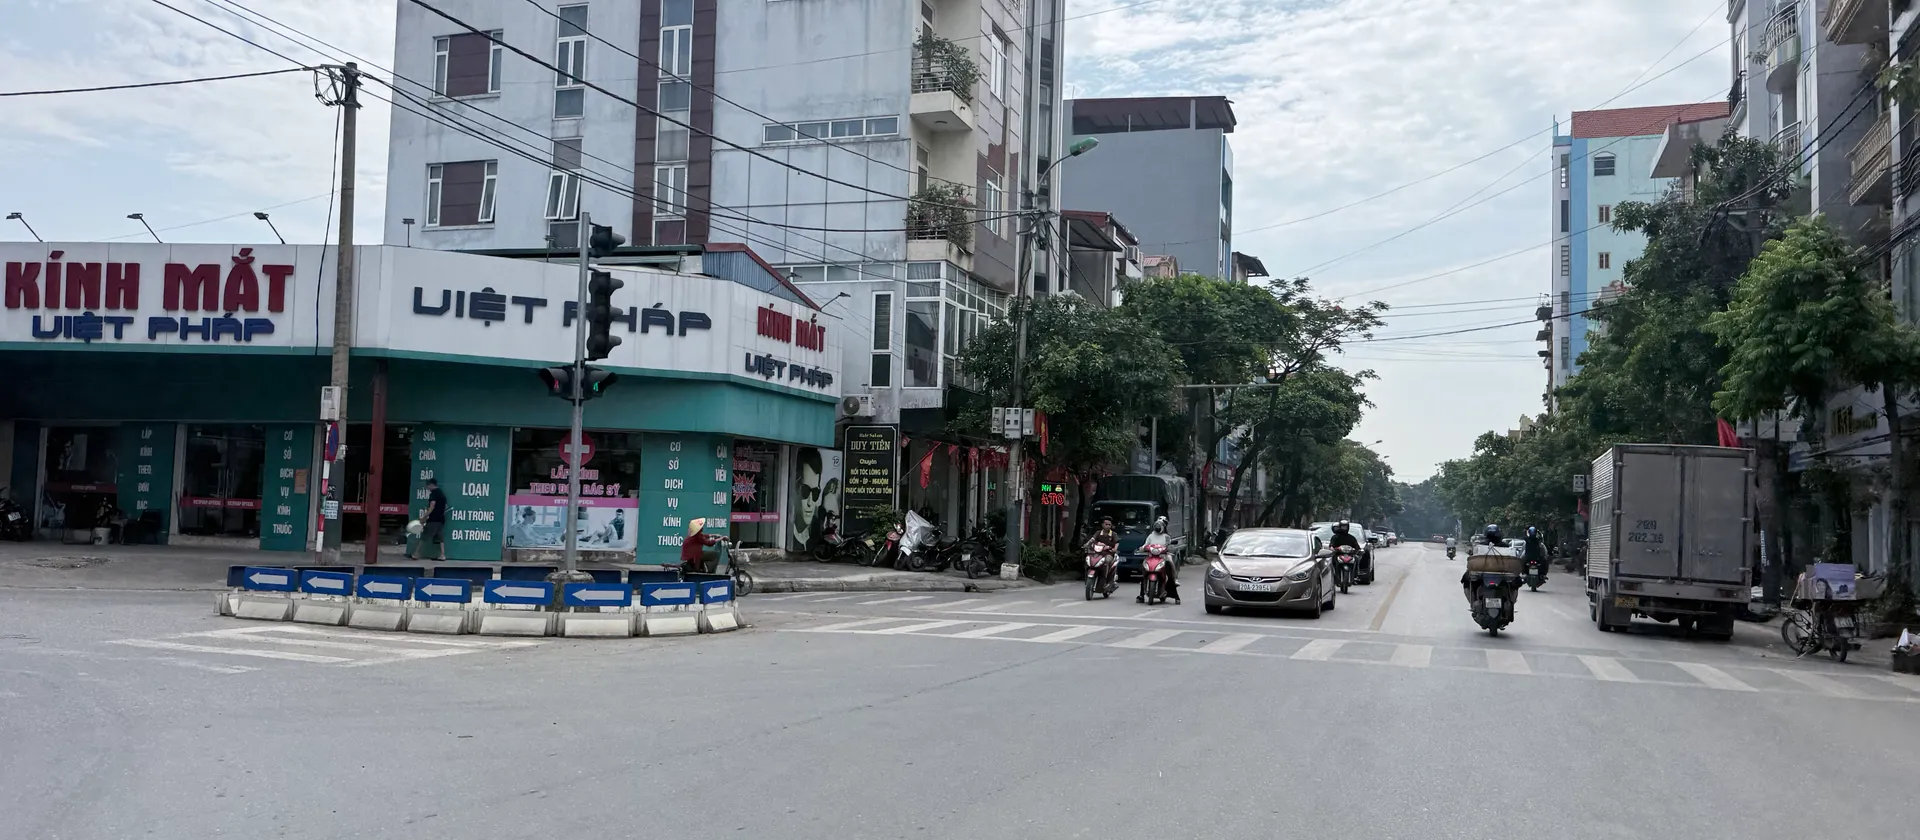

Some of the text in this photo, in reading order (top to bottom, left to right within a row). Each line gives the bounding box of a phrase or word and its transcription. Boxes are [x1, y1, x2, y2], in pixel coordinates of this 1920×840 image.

[5, 248, 294, 312] KÍNH MẮT
[148, 312, 274, 342] PHÁP
[758, 303, 826, 353] KÍNH MẮT
[790, 364, 833, 389] PHÁP
[284, 430, 294, 440] CƠ
[466, 433, 488, 450] CẬN
[670, 440, 681, 452] CƠ
[716, 443, 727, 460] CẬN
[851, 441, 868, 450] DUY
[283, 446, 292, 459] SỞ
[465, 453, 488, 472] VIỄN
[668, 457, 679, 470] SỞ
[580, 467, 599, 480] ÍNH
[462, 483, 490, 498] LOẠN
[582, 483, 604, 495] BÁC
[664, 479, 683, 490] DỊCH
[281, 486, 289, 498] VỤ
[416, 487, 431, 499] HÀN
[668, 498, 678, 510] VỤ
[714, 492, 727, 506] LOẠN
[277, 504, 291, 516] KÍNH
[452, 508, 494, 521] HAI TRÒNG
[273, 521, 292, 534] THUỐC
[663, 515, 681, 527] KÍNH
[452, 528, 491, 540] ĐA TRÒNG
[658, 533, 683, 546] THUỐC
